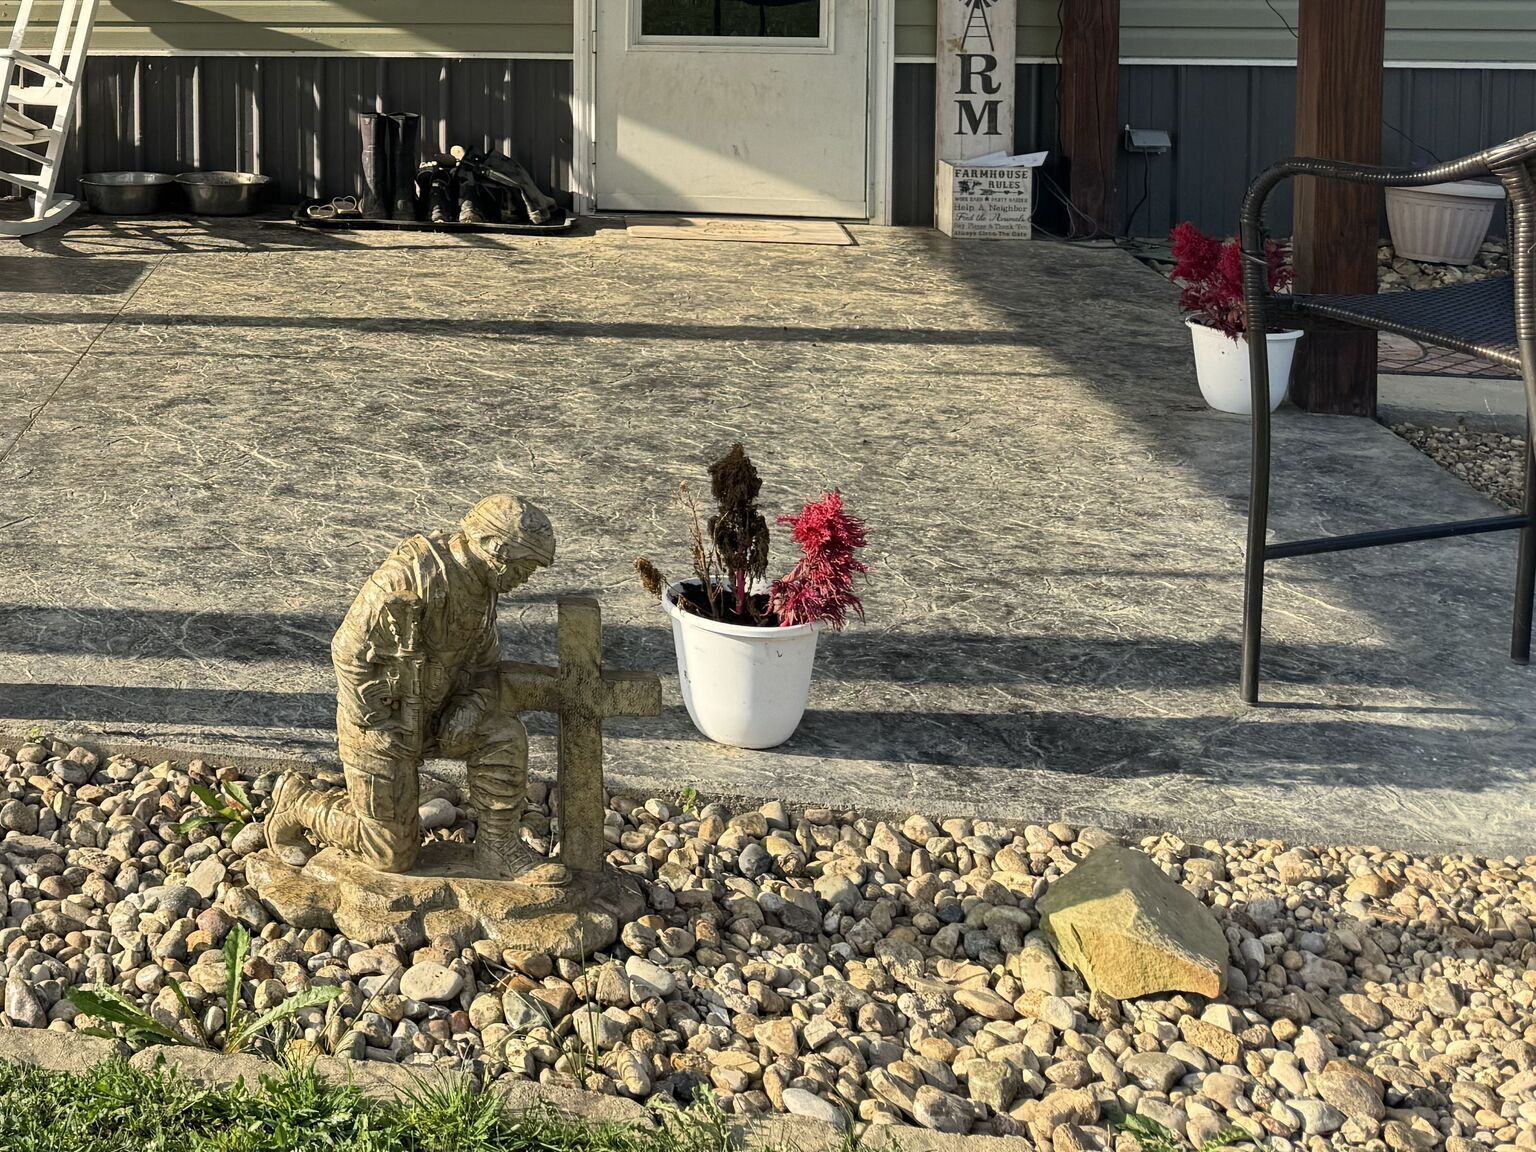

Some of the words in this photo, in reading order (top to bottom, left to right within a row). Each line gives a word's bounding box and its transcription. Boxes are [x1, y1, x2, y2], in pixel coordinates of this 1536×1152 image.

[954, 169, 1029, 179] FARMHOUSE
[988, 180, 1021, 189] RULES
[954, 203, 975, 212] Help
[989, 204, 1028, 212] Neighbor
